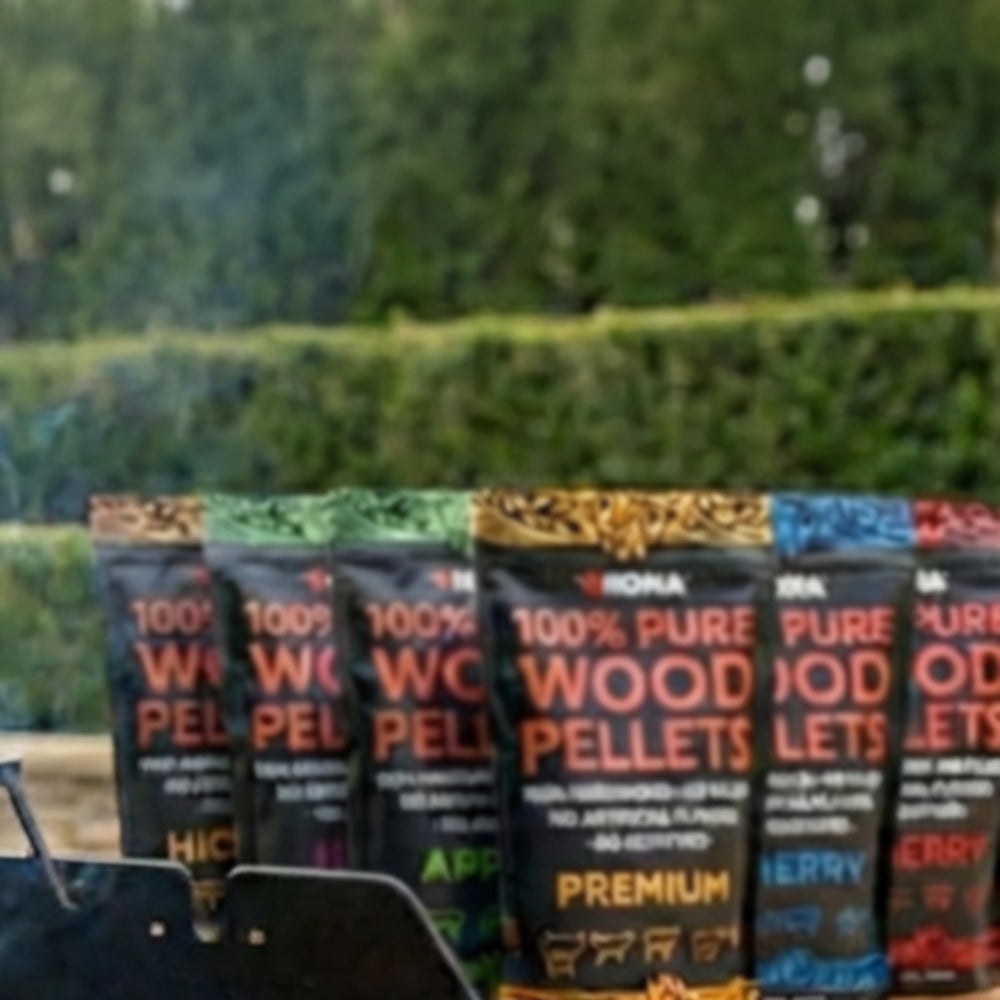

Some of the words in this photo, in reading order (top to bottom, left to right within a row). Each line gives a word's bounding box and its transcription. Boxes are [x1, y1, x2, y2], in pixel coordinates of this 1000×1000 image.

[513, 607, 626, 647] 100%
[637, 607, 755, 647] PURE
[781, 607, 895, 645] PURE
[519, 652, 754, 713] WOOD
[521, 715, 751, 776] PELLETS
[774, 711, 887, 763] LETS
[556, 869, 730, 909] PREMIUM
